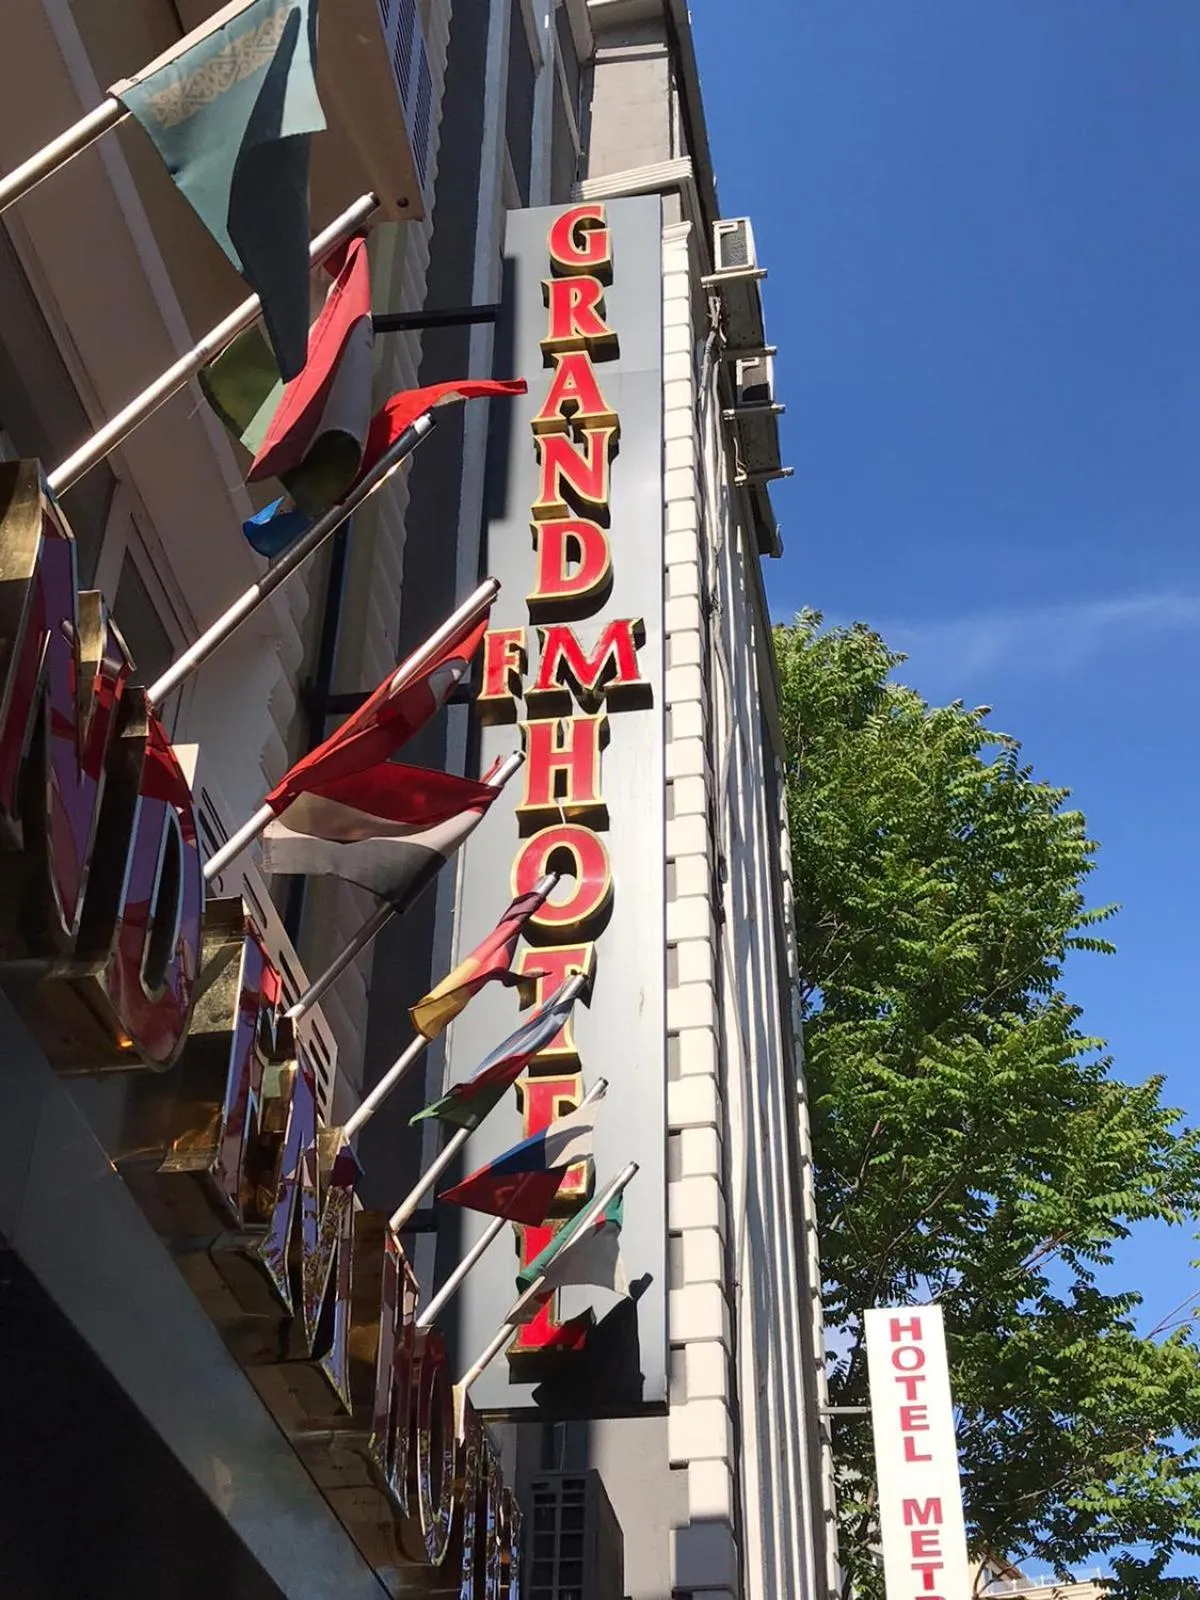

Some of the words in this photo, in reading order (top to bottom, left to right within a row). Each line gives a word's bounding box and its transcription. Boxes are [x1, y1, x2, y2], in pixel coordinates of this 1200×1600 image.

[527, 203, 619, 605] GRAND
[477, 617, 645, 702] FM
[889, 1316, 933, 1462] HOTEL
[901, 1497, 946, 1600] MET
